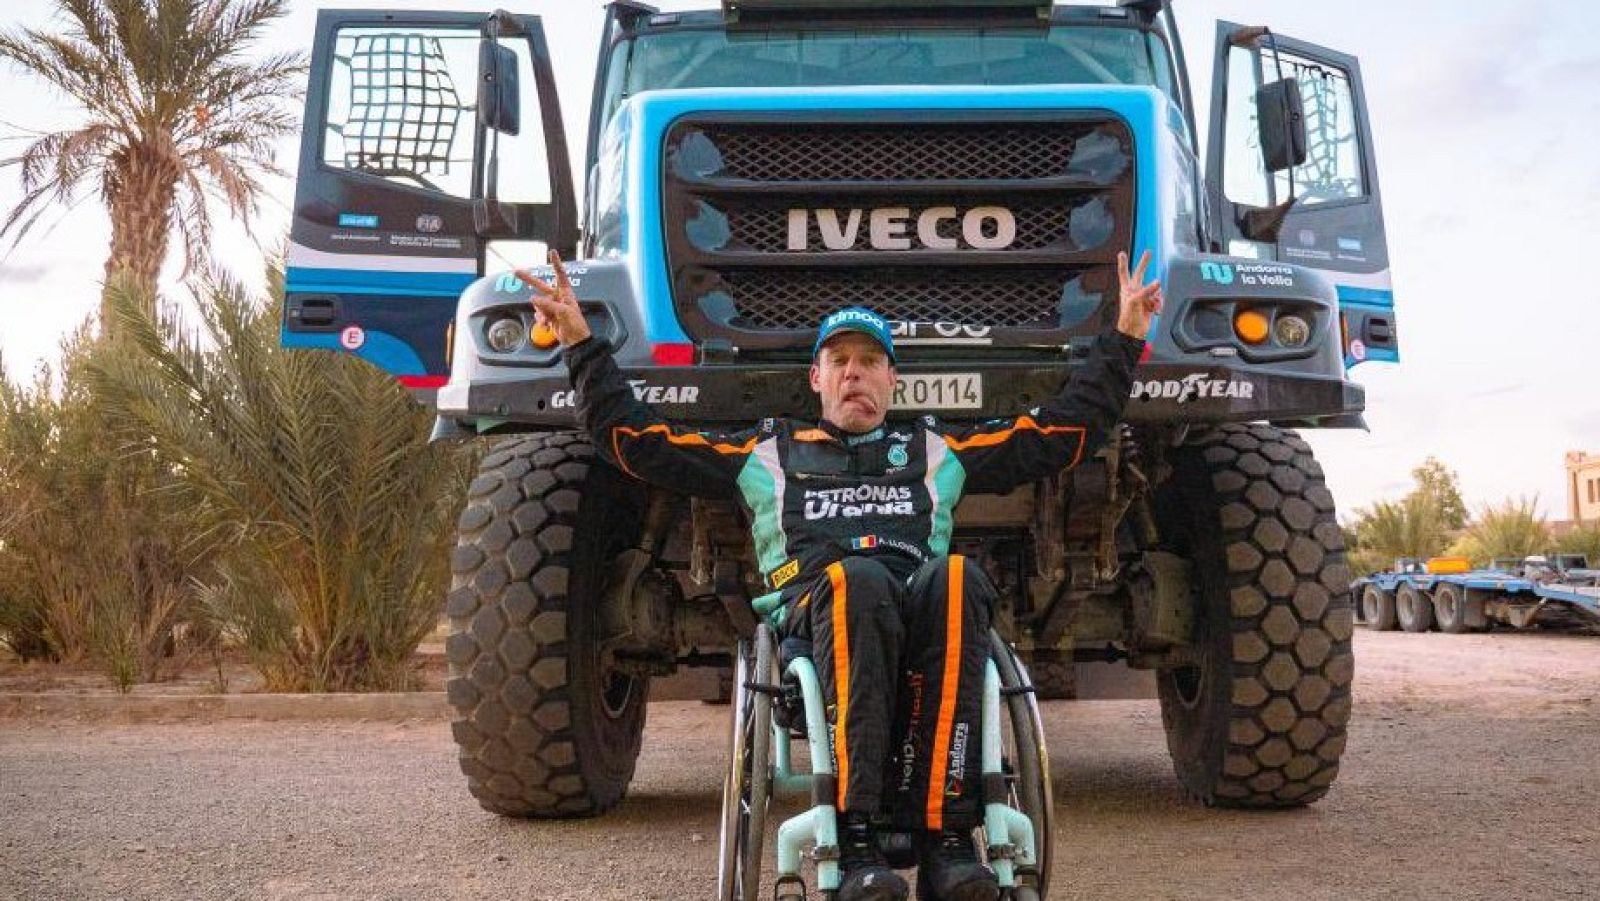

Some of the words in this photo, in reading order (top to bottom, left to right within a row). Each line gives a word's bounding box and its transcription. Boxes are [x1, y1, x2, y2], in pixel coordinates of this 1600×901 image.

[787, 206, 1016, 251] IVECO
[1235, 263, 1293, 275] Andorra
[1240, 273, 1256, 285] la
[1257, 274, 1293, 287] Vella
[347, 330, 360, 344] E
[886, 319, 993, 338] arco
[892, 378, 978, 405] R0114
[1129, 372, 1254, 404] OODYEAR
[803, 484, 912, 502] PETRONAS
[949, 722, 965, 780] Andorra
